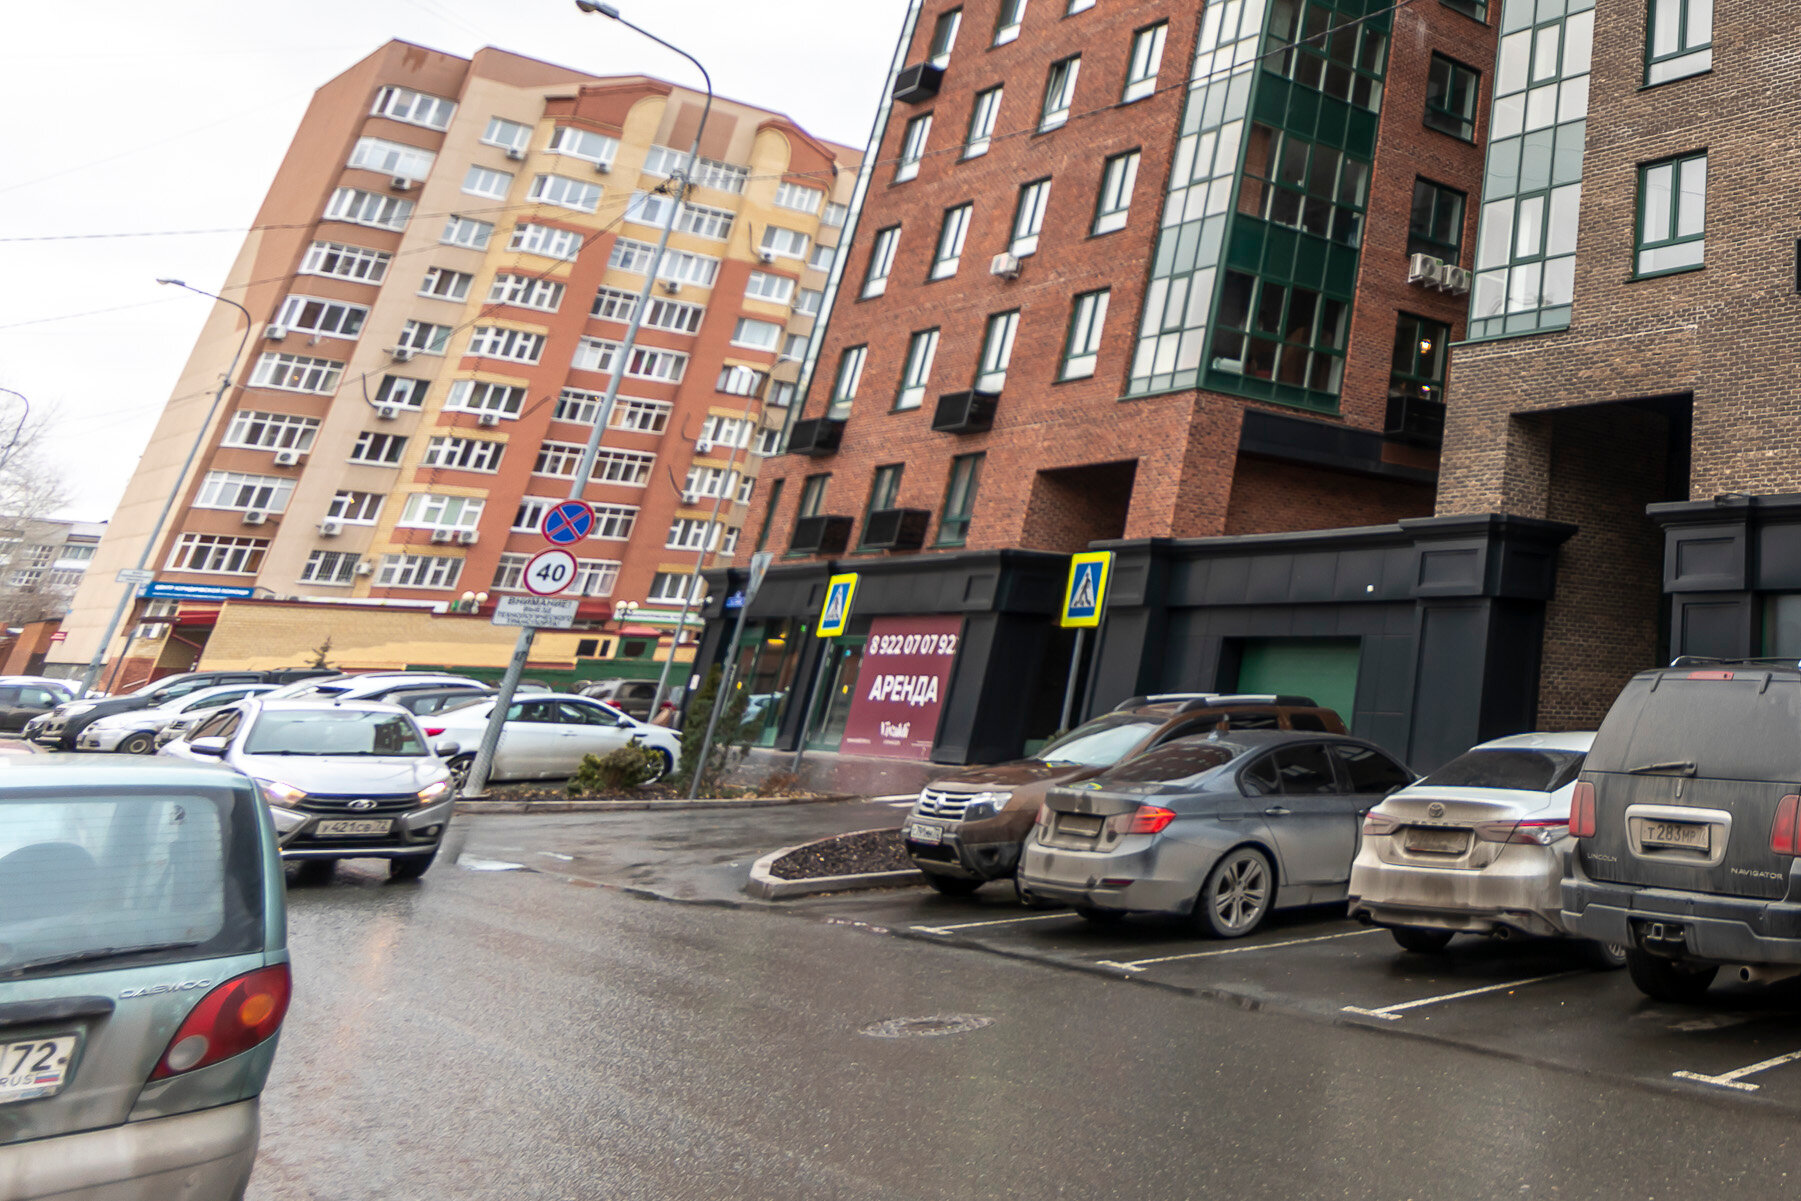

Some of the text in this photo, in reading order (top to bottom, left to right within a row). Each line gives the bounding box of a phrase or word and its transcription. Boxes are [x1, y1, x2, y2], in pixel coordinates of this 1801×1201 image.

[536, 563, 566, 582] 40
[869, 634, 880, 655] 8
[880, 634, 904, 655] 922
[903, 634, 922, 655] 07
[920, 634, 939, 655] 07
[868, 674, 939, 707] АРЕНДА
[1587, 852, 1617, 862] LINCOLN
[1731, 867, 1784, 880] NAVIGATOR
[118, 978, 213, 1000] DAEWOO
[9, 1041, 57, 1075] 72
